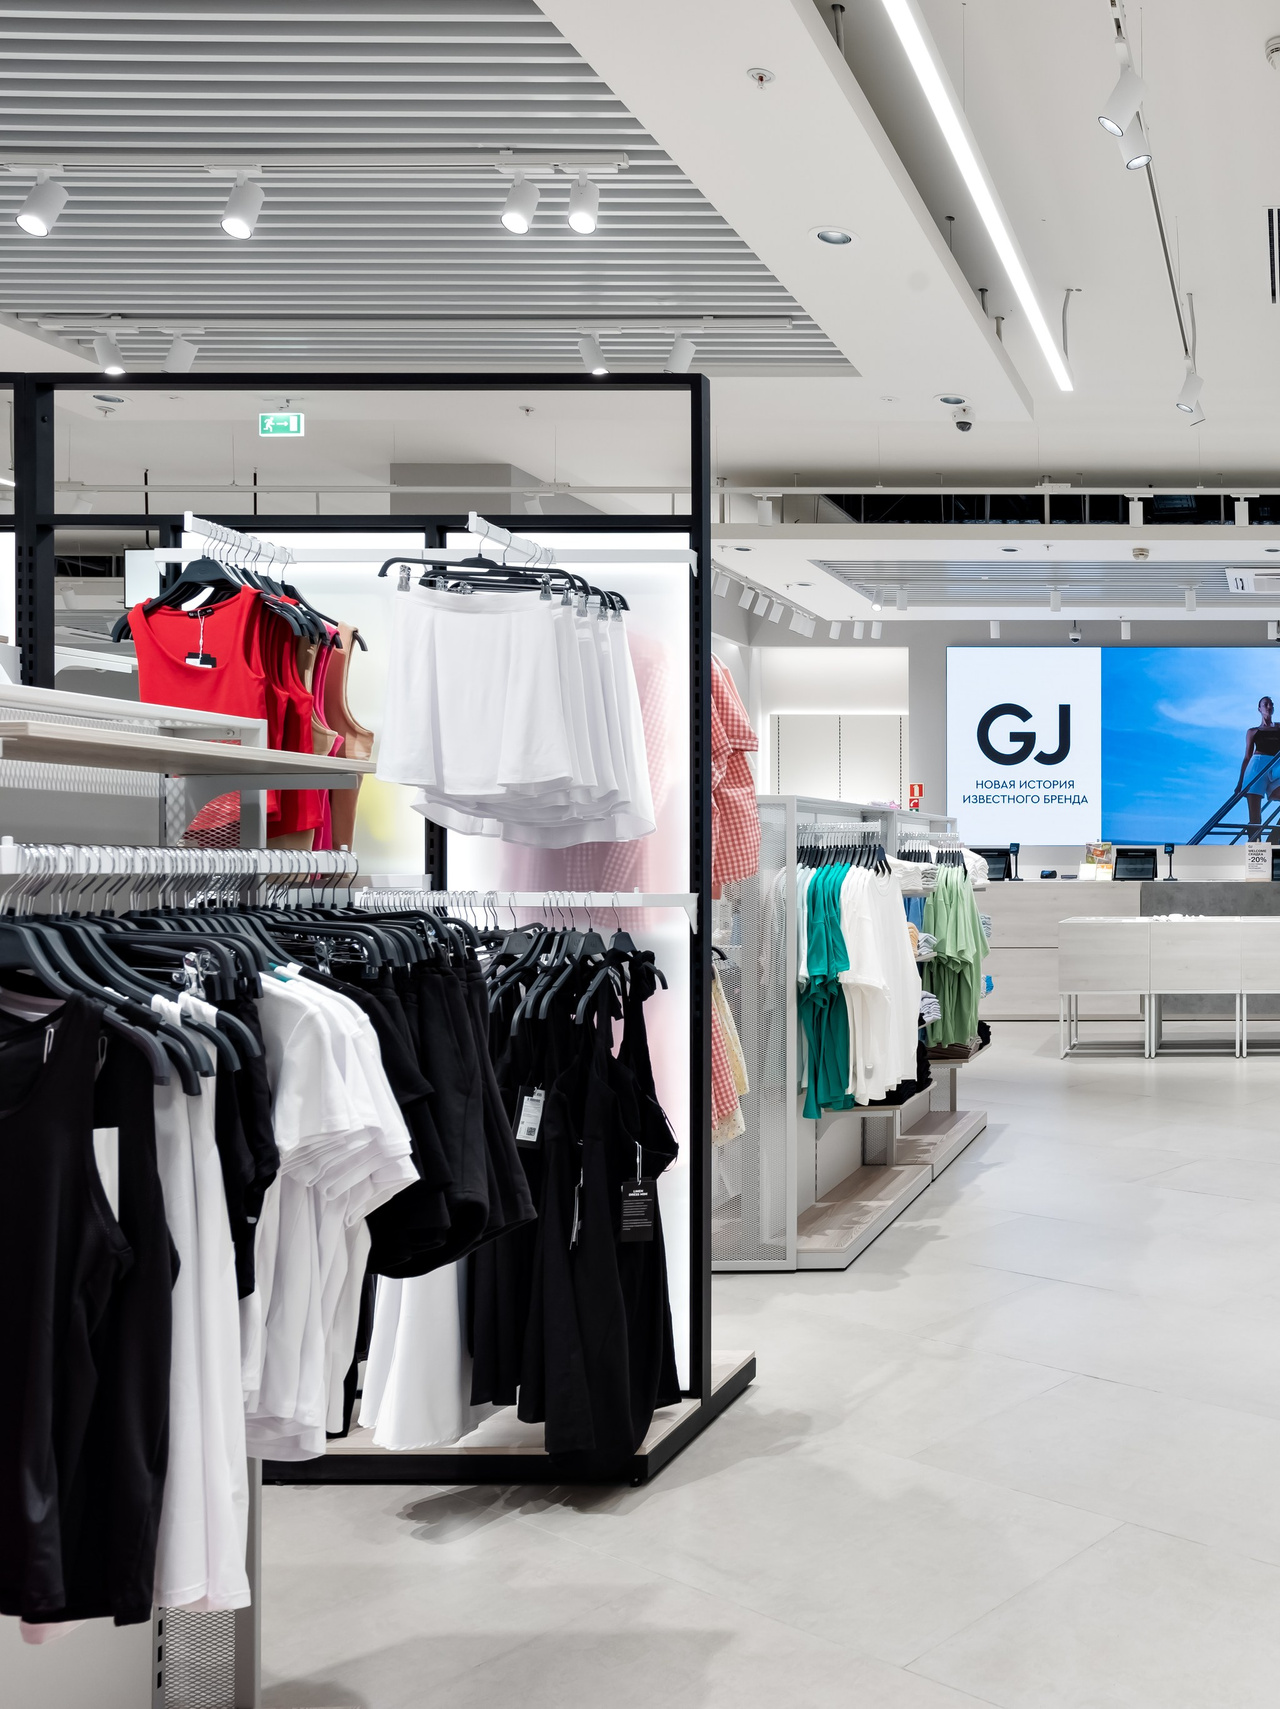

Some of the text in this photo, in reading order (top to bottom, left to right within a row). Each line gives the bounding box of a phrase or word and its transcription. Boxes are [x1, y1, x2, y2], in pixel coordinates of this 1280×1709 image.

[977, 703, 1071, 766] GJ
[975, 780, 1075, 789] НОВАЯ ИСТОРИЯ
[962, 795, 1089, 805] ИЗВЕСТНОГО БРЕНДА
